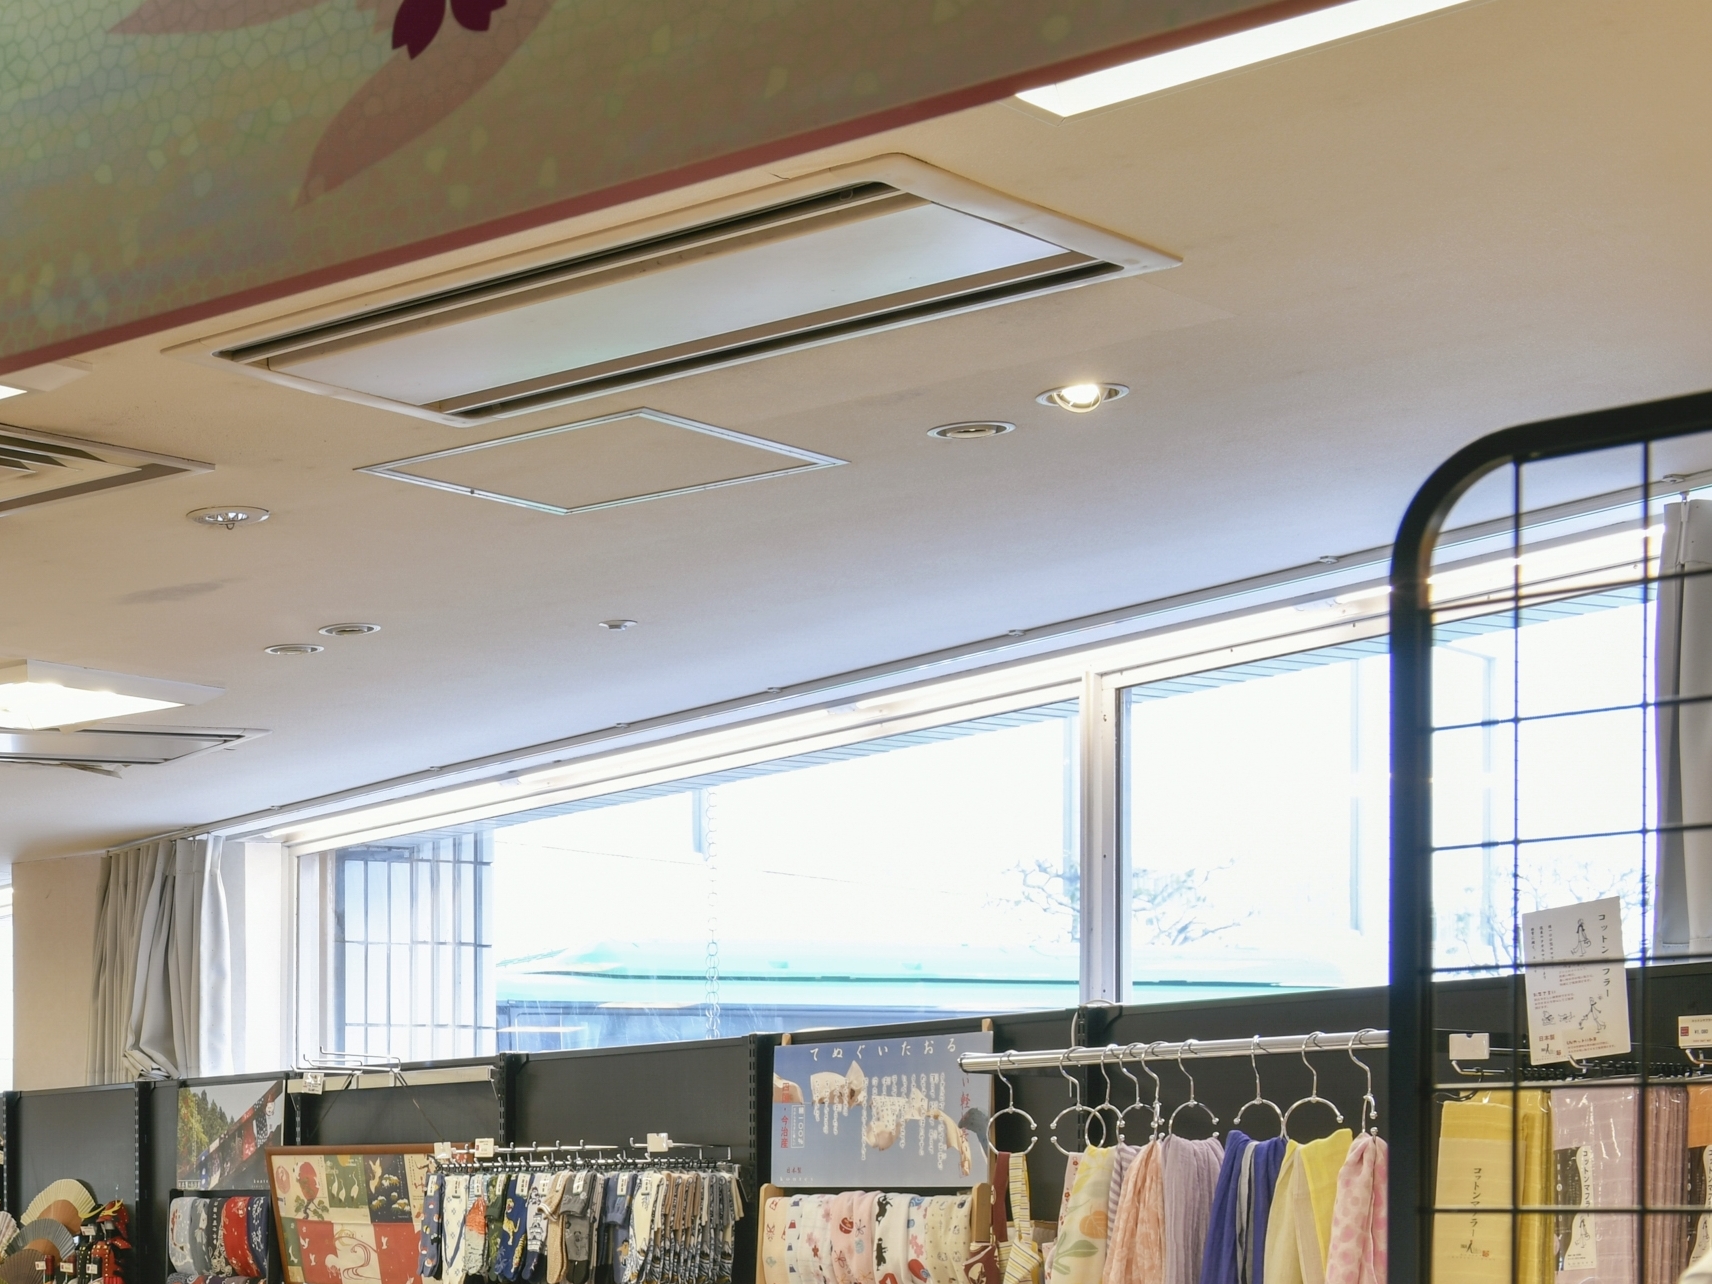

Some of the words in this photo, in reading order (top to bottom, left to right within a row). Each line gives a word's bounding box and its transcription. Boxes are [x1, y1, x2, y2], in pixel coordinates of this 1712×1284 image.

[1598, 914, 1611, 997] コットンフラー
[810, 1038, 957, 1061] てぬぐいたおる
